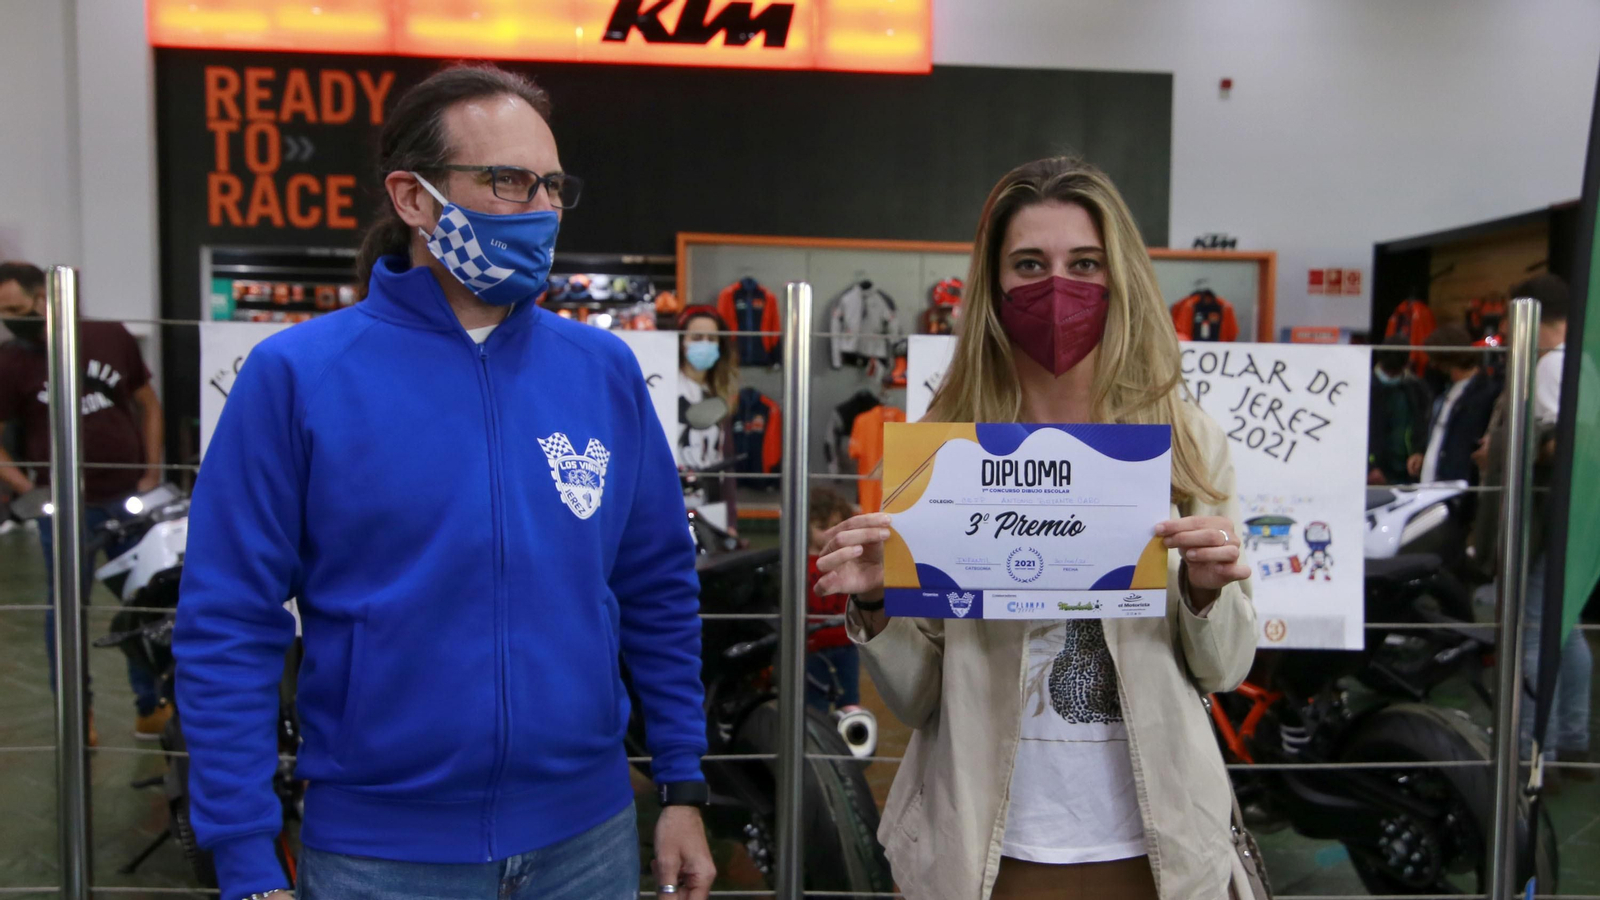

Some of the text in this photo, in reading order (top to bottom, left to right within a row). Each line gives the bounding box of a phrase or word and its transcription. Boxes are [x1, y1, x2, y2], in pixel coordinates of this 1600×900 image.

[602, 0, 795, 48] KTM
[205, 66, 396, 125] READY
[207, 120, 281, 174] TO
[208, 172, 358, 229] RACE
[490, 239, 507, 250] LITO
[1180, 349, 1348, 406] COLAR DE
[1230, 387, 1330, 442] JEREZ
[1227, 415, 1297, 463] 2021
[560, 460, 577, 470] LOS
[982, 459, 1071, 487] DIPLOMA
[565, 488, 586, 514] JEREZ
[994, 511, 1086, 539] Premio
